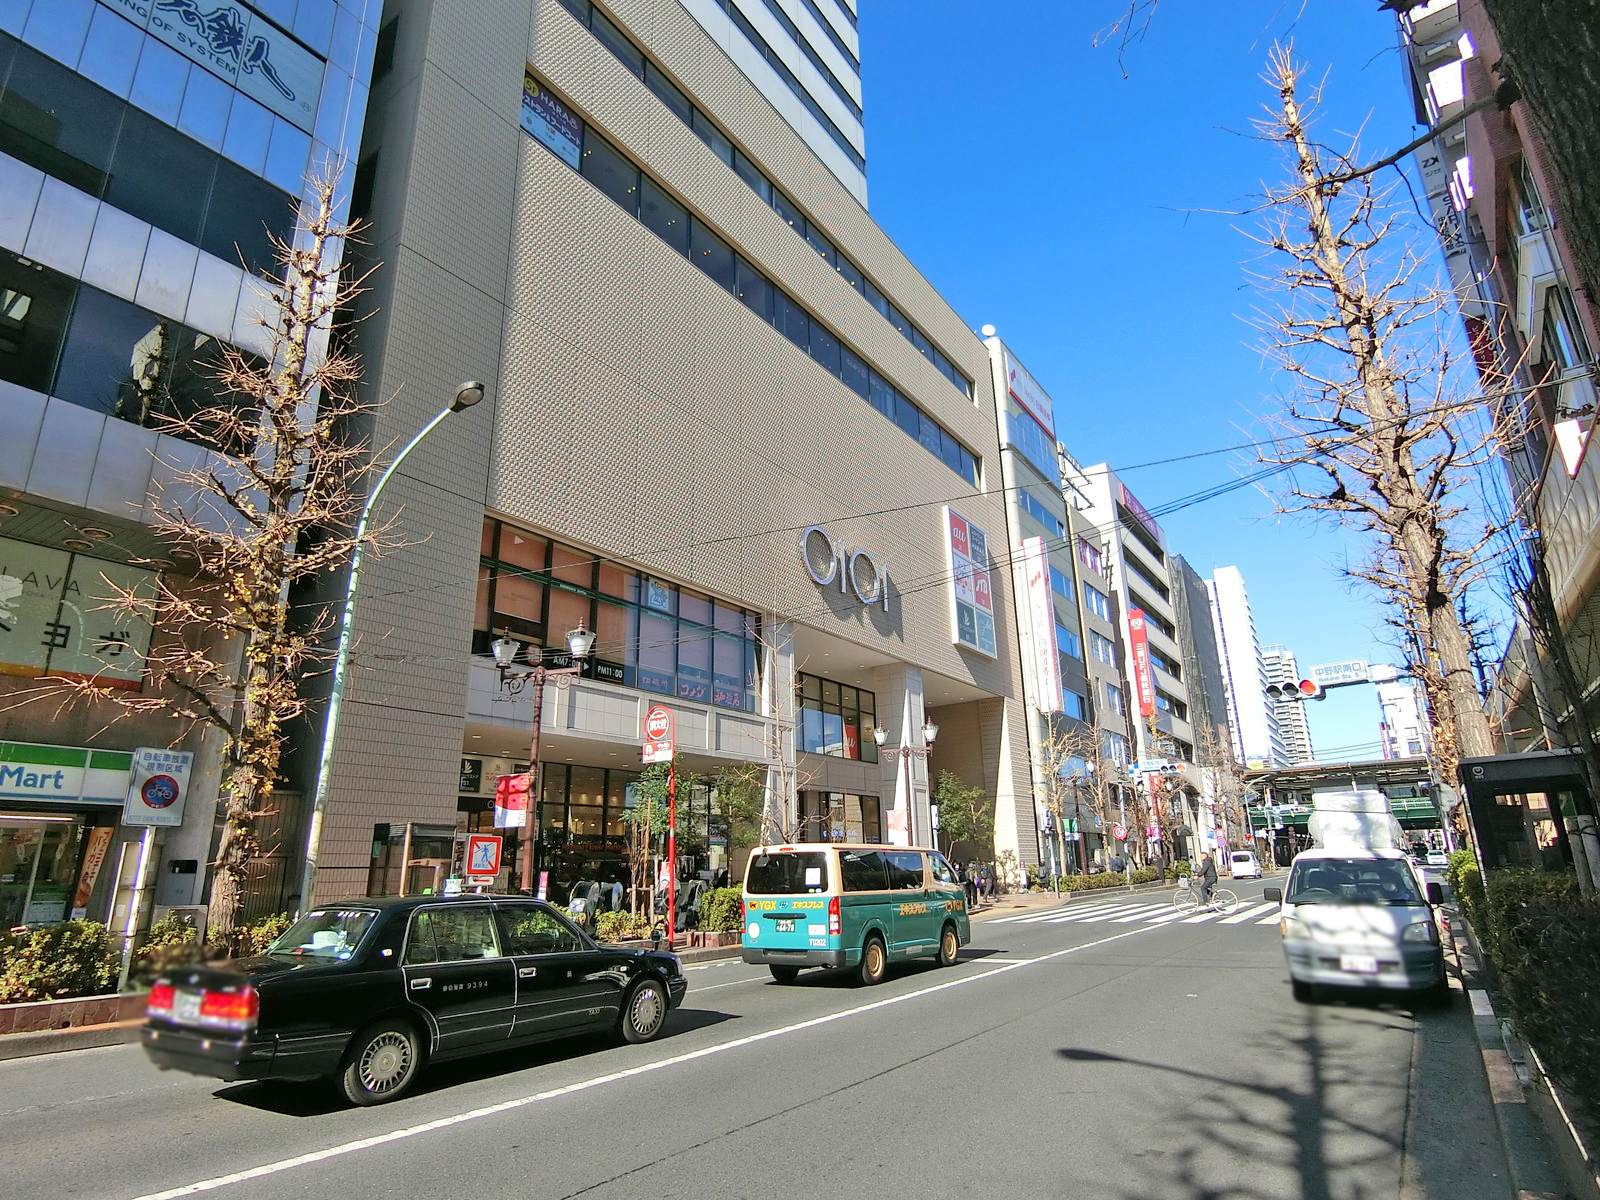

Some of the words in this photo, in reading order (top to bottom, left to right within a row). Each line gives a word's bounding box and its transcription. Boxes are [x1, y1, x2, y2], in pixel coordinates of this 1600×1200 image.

[152, 17, 174, 32] OF
[177, 32, 237, 75] SYSTEM
[521, 95, 581, 145] ストラン&フードコート
[597, 665, 623, 679] PM11:00
[1315, 662, 1361, 676] 中野駅南口
[143, 752, 189, 765] 自転車放置
[145, 762, 184, 774] 規制区域
[0, 764, 64, 790] Mart
[759, 901, 777, 911] YGX
[467, 981, 488, 989] 9394
